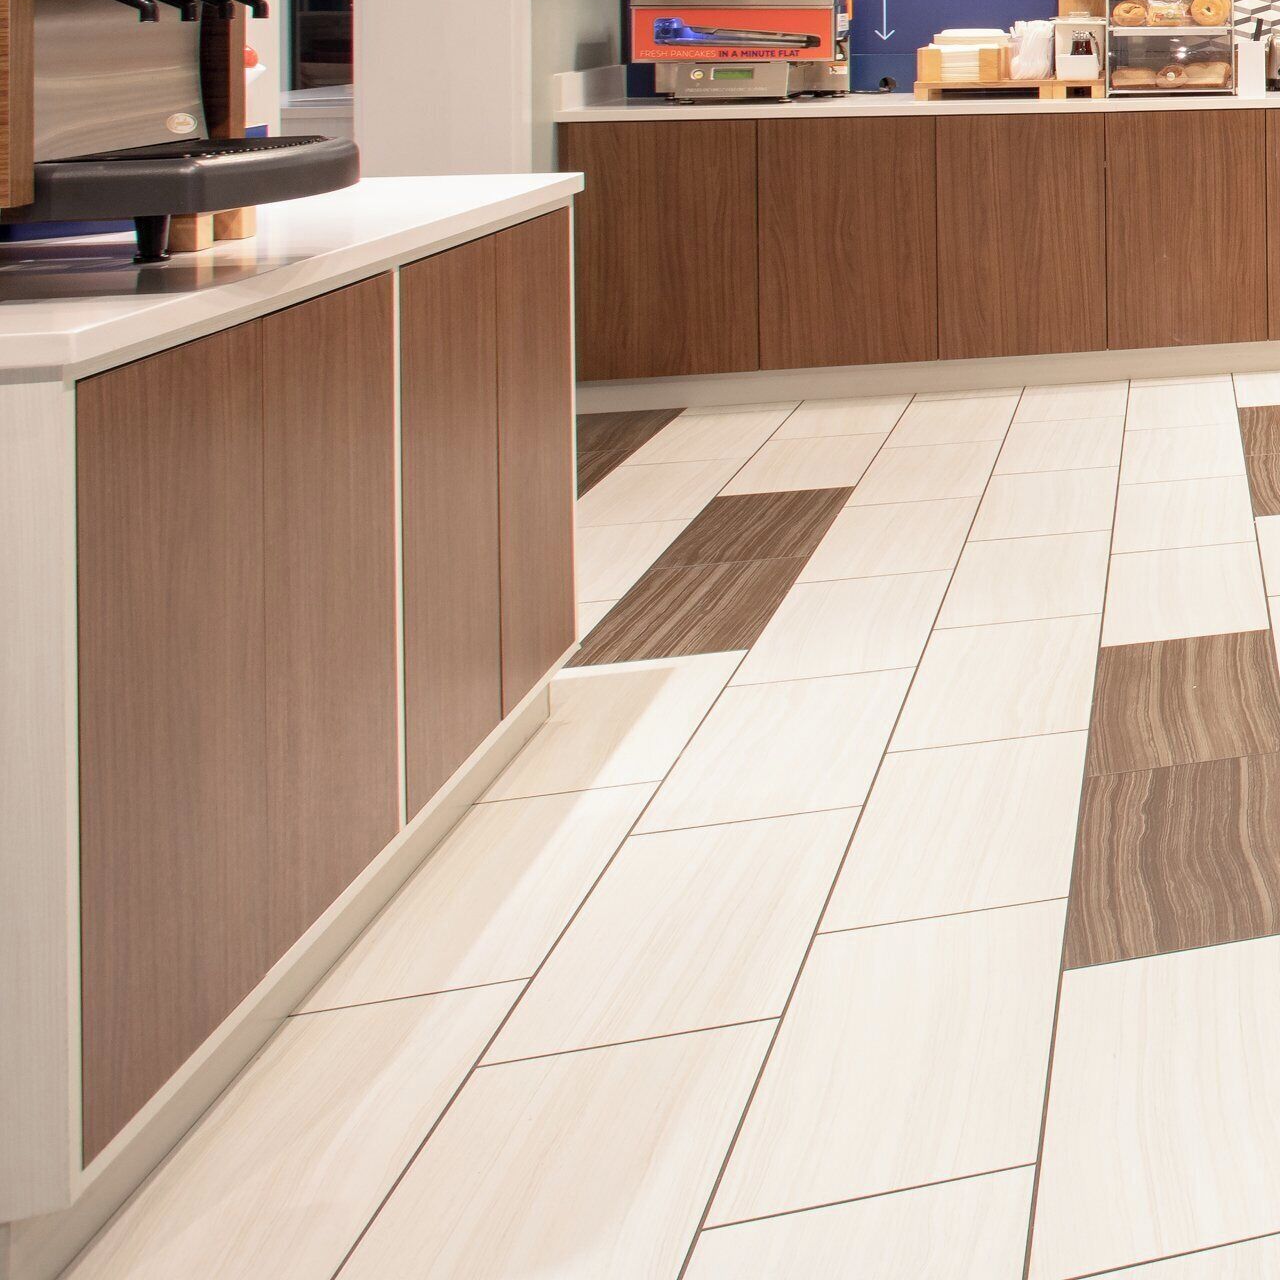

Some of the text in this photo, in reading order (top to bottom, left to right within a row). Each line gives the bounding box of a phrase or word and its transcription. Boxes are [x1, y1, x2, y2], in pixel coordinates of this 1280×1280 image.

[640, 49, 800, 58] FRESH PANCAKES IN A MINUTE FLAT
